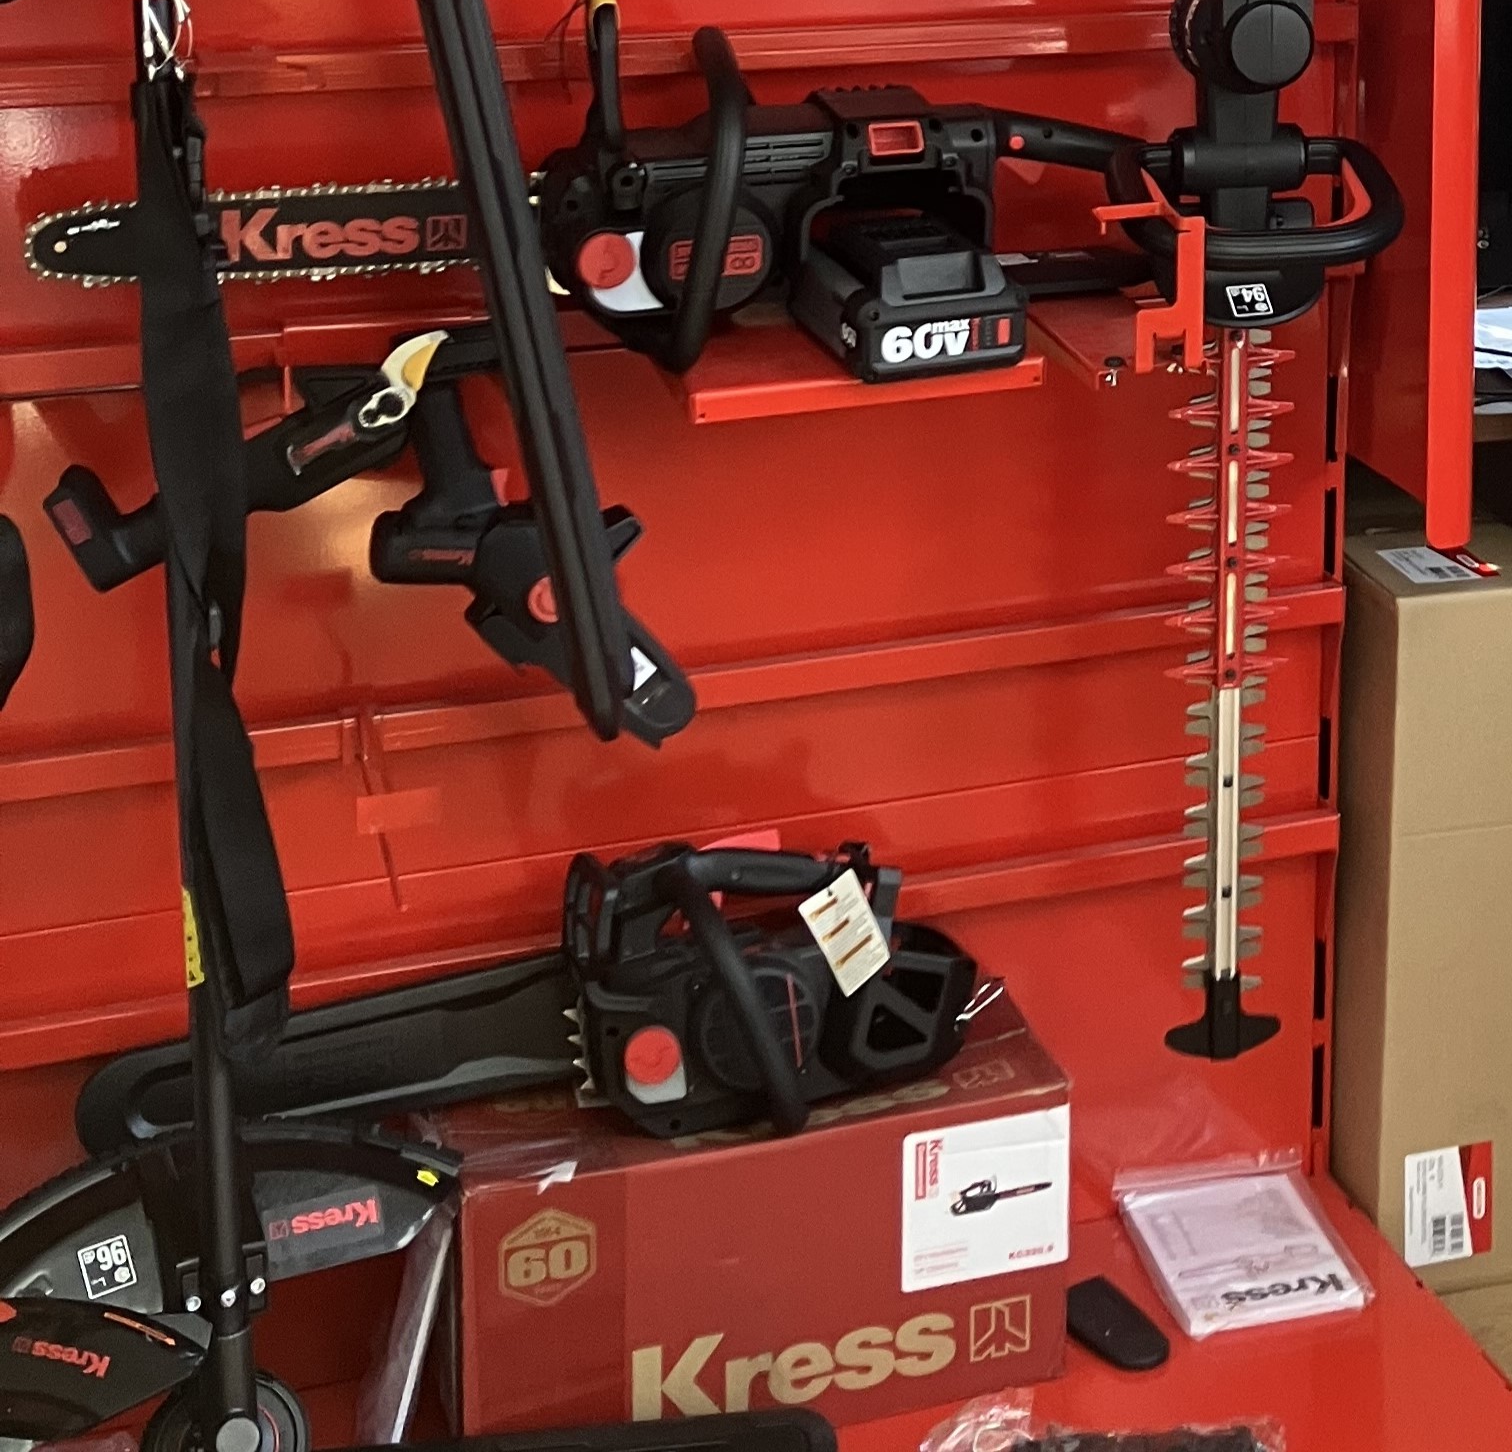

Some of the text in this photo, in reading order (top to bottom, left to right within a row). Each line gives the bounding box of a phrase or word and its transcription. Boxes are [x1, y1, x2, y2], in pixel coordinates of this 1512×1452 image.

[221, 208, 420, 262] Kress
[931, 319, 970, 334] max
[291, 1198, 379, 1234] Kress
[97, 1241, 126, 1270] 96
[507, 1241, 587, 1287] 60
[1221, 1263, 1344, 1304] Kress
[32, 1341, 111, 1378] Kress
[632, 1313, 957, 1422] Kress
